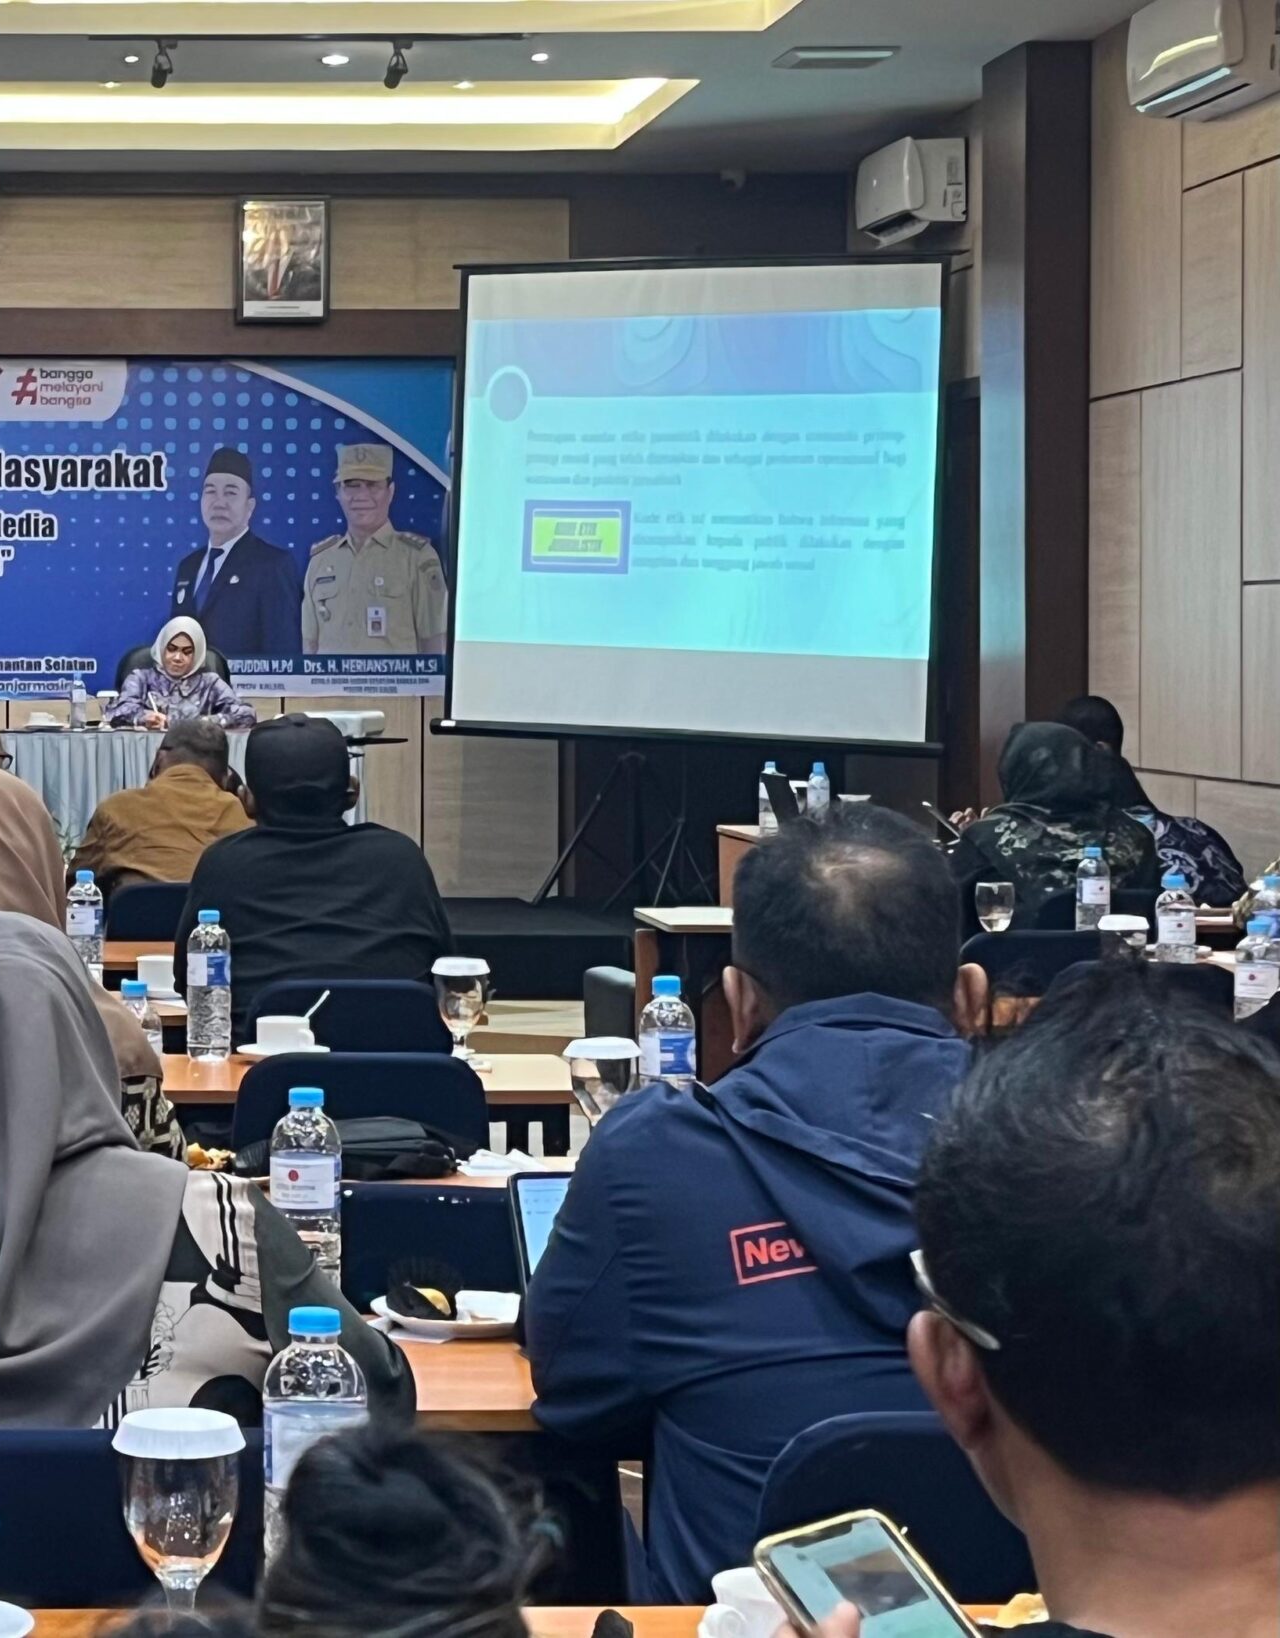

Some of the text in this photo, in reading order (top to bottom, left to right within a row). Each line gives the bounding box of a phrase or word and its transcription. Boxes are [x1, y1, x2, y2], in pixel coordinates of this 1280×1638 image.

[39, 367, 93, 380] bangga
[39, 380, 104, 394] melayani
[43, 658, 95, 672] Selatan
[303, 659, 325, 673] Drs.
[327, 659, 339, 673] H.
